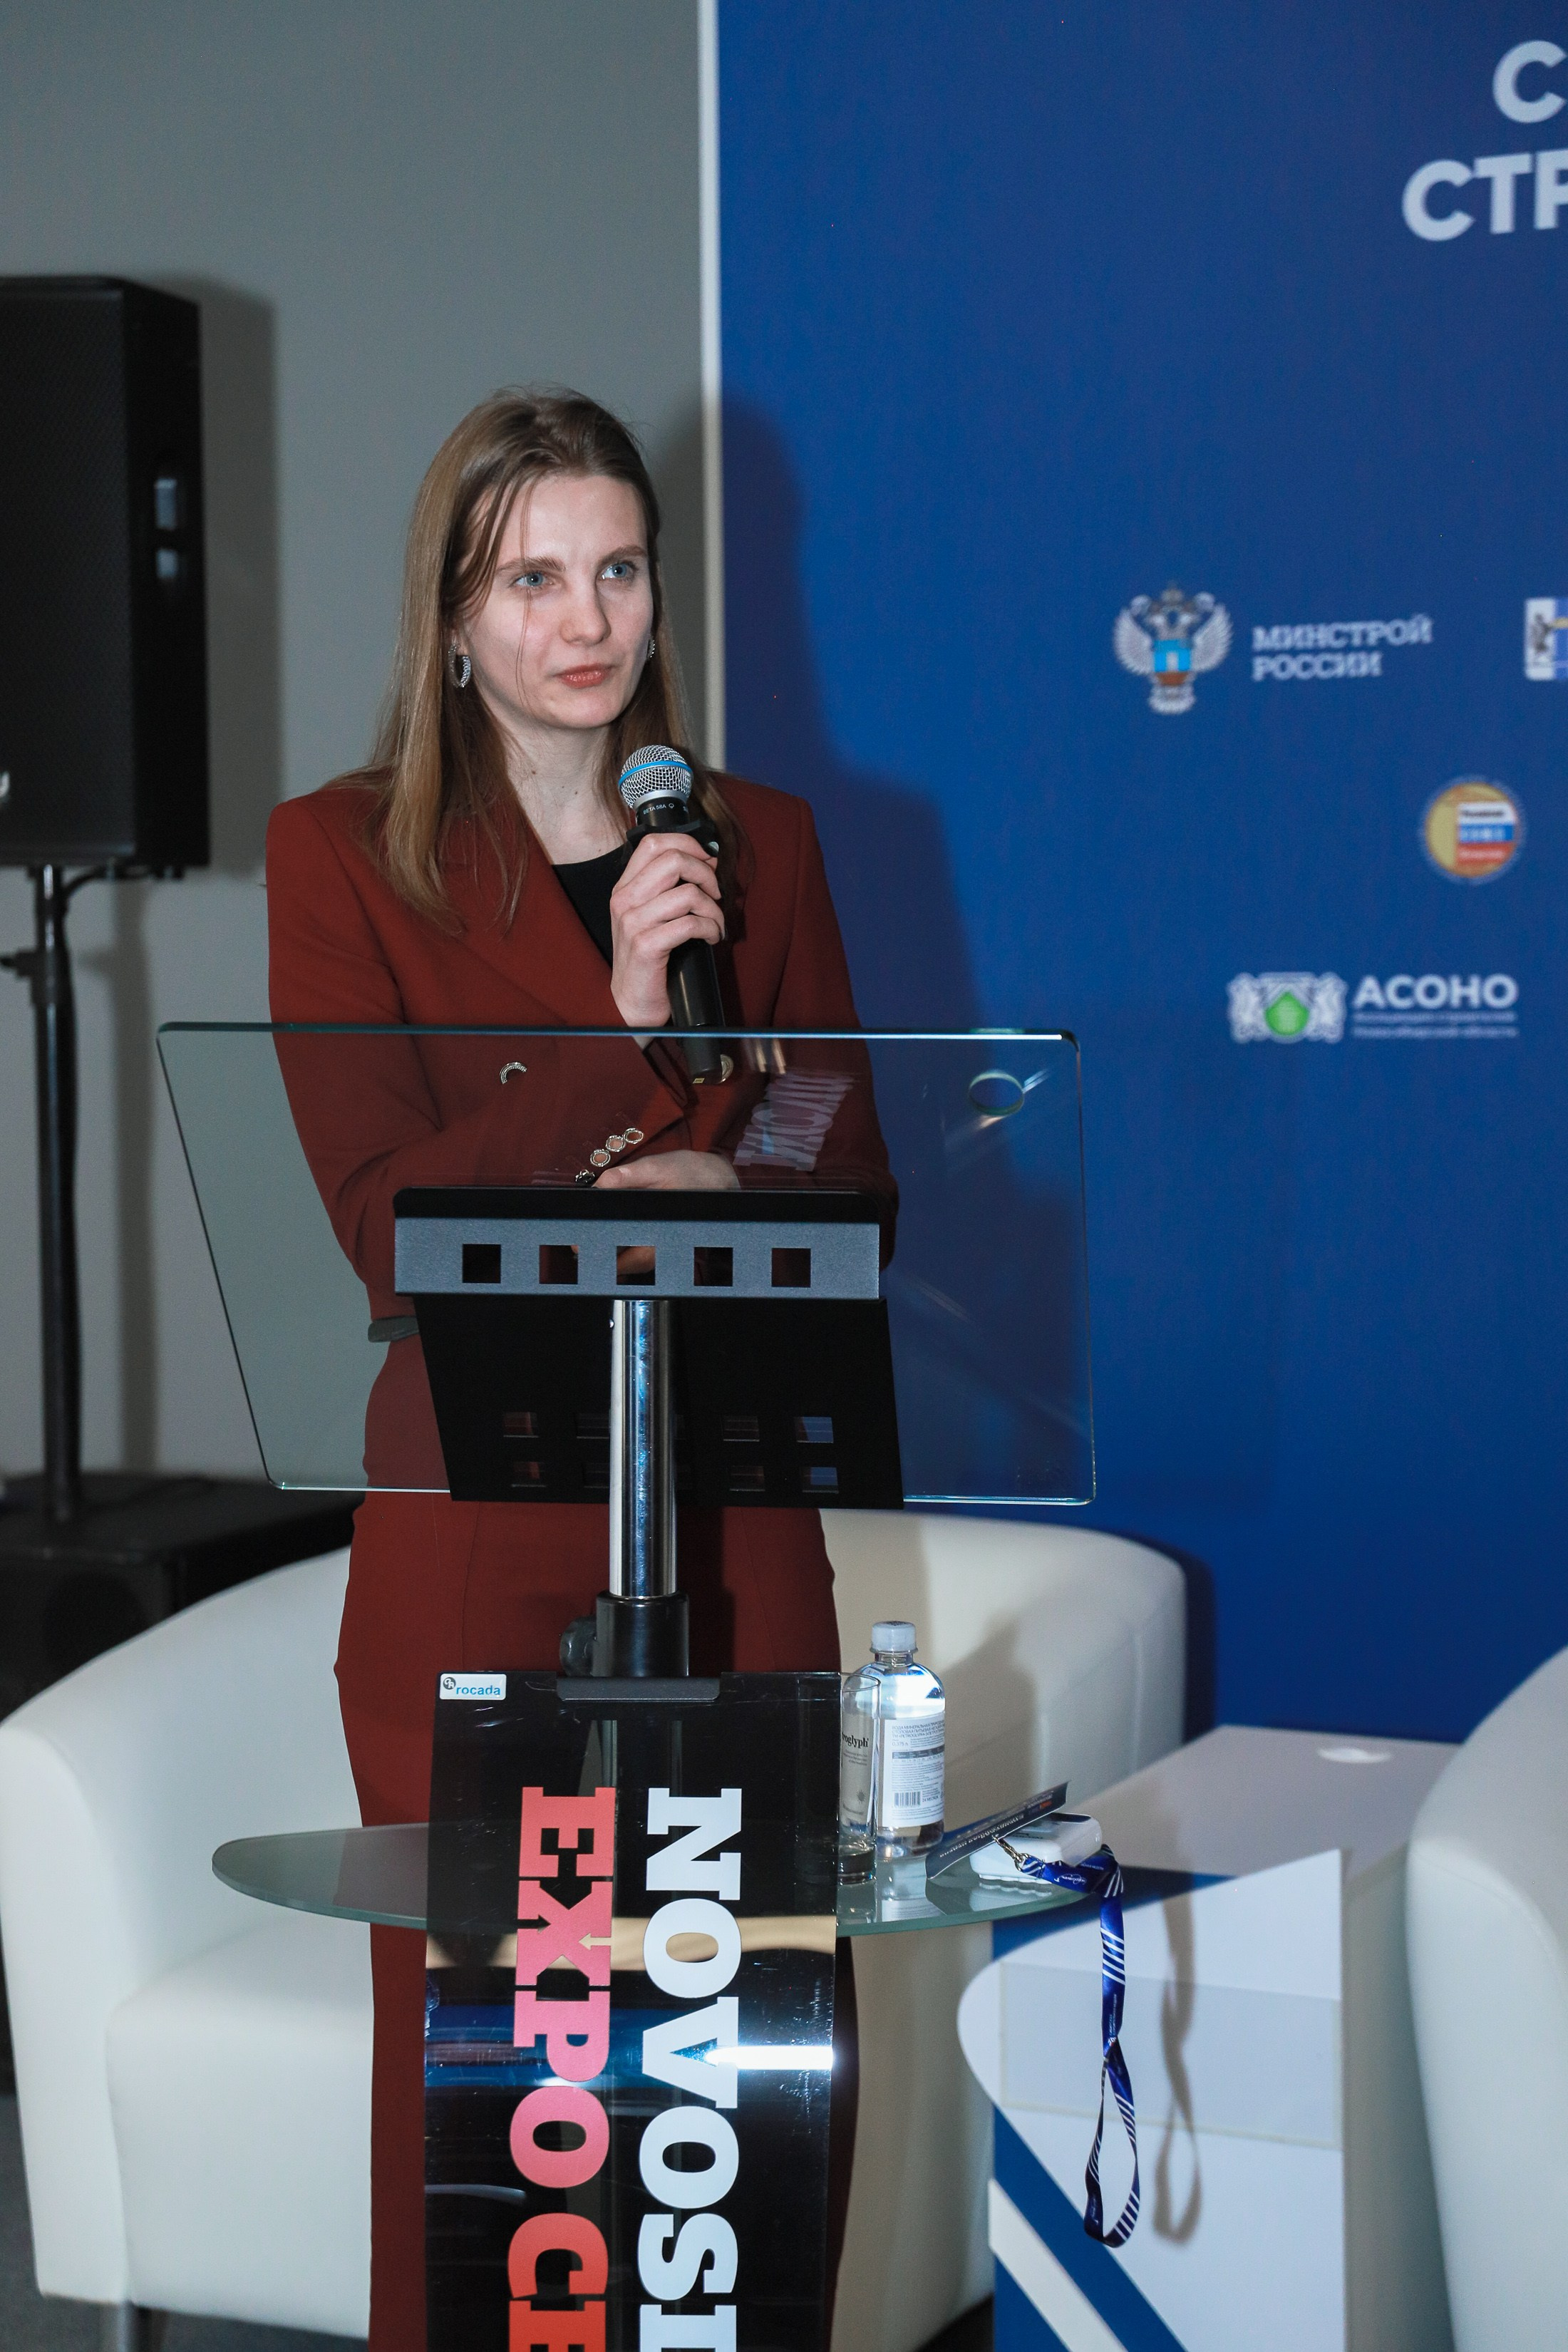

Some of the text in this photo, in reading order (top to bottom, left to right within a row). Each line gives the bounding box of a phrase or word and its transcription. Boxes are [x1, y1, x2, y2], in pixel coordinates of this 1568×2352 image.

[1252, 614, 1433, 652] МИНСТРОЙ
[1252, 651, 1383, 682] РОССИИ
[643, 806, 656, 815] BETA
[1353, 974, 1519, 1009] АСОНО
[456, 1685, 500, 1695] rocada
[638, 1788, 743, 2352] NOVOSI
